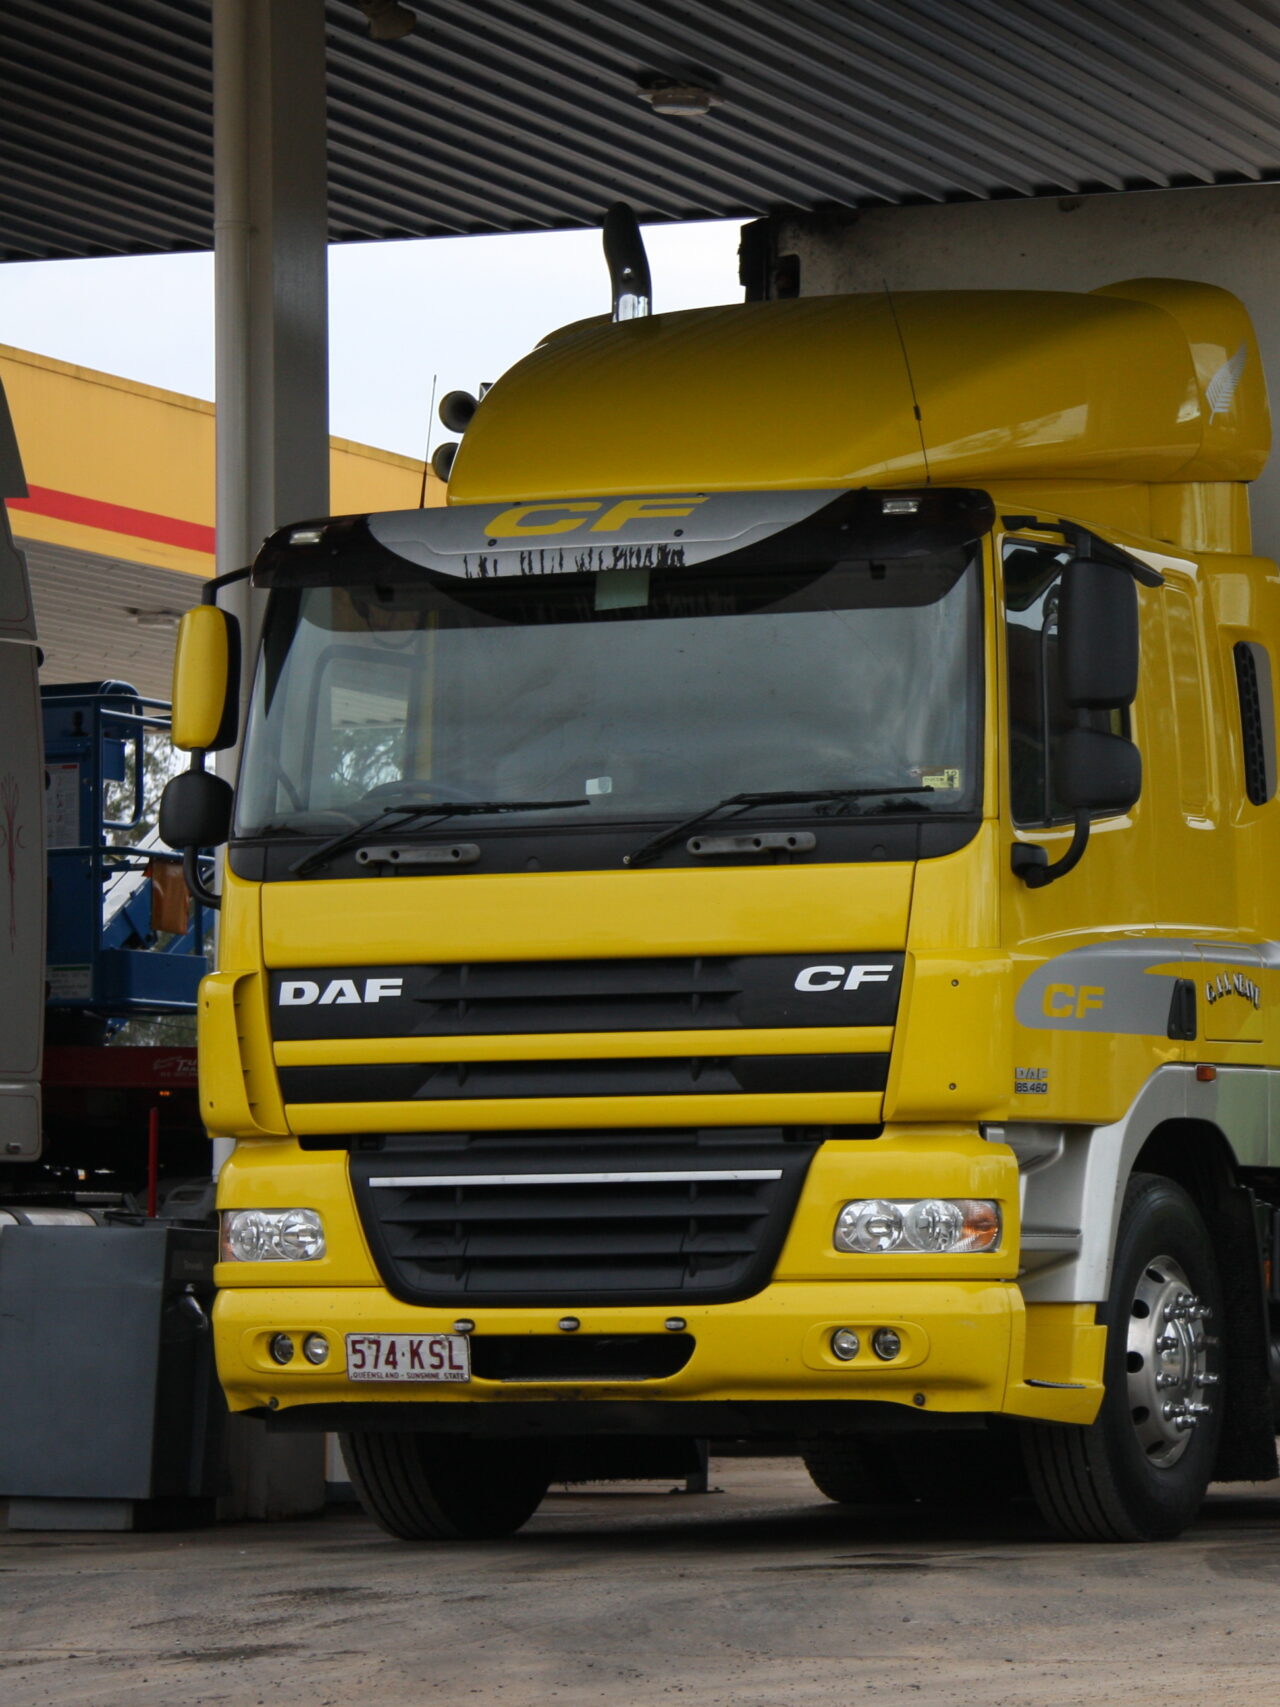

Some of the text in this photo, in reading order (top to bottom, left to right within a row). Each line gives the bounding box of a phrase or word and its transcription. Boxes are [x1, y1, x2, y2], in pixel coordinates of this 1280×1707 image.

[484, 497, 711, 538] CF
[278, 977, 404, 1006] DAF
[794, 964, 894, 992] CF
[1041, 983, 1105, 1019] CF
[1015, 1067, 1049, 1080] DAF
[353, 1372, 400, 1380] QUEENSLAND
[406, 1372, 440, 1380] SUNSHINE
[444, 1372, 465, 1380] STATE
